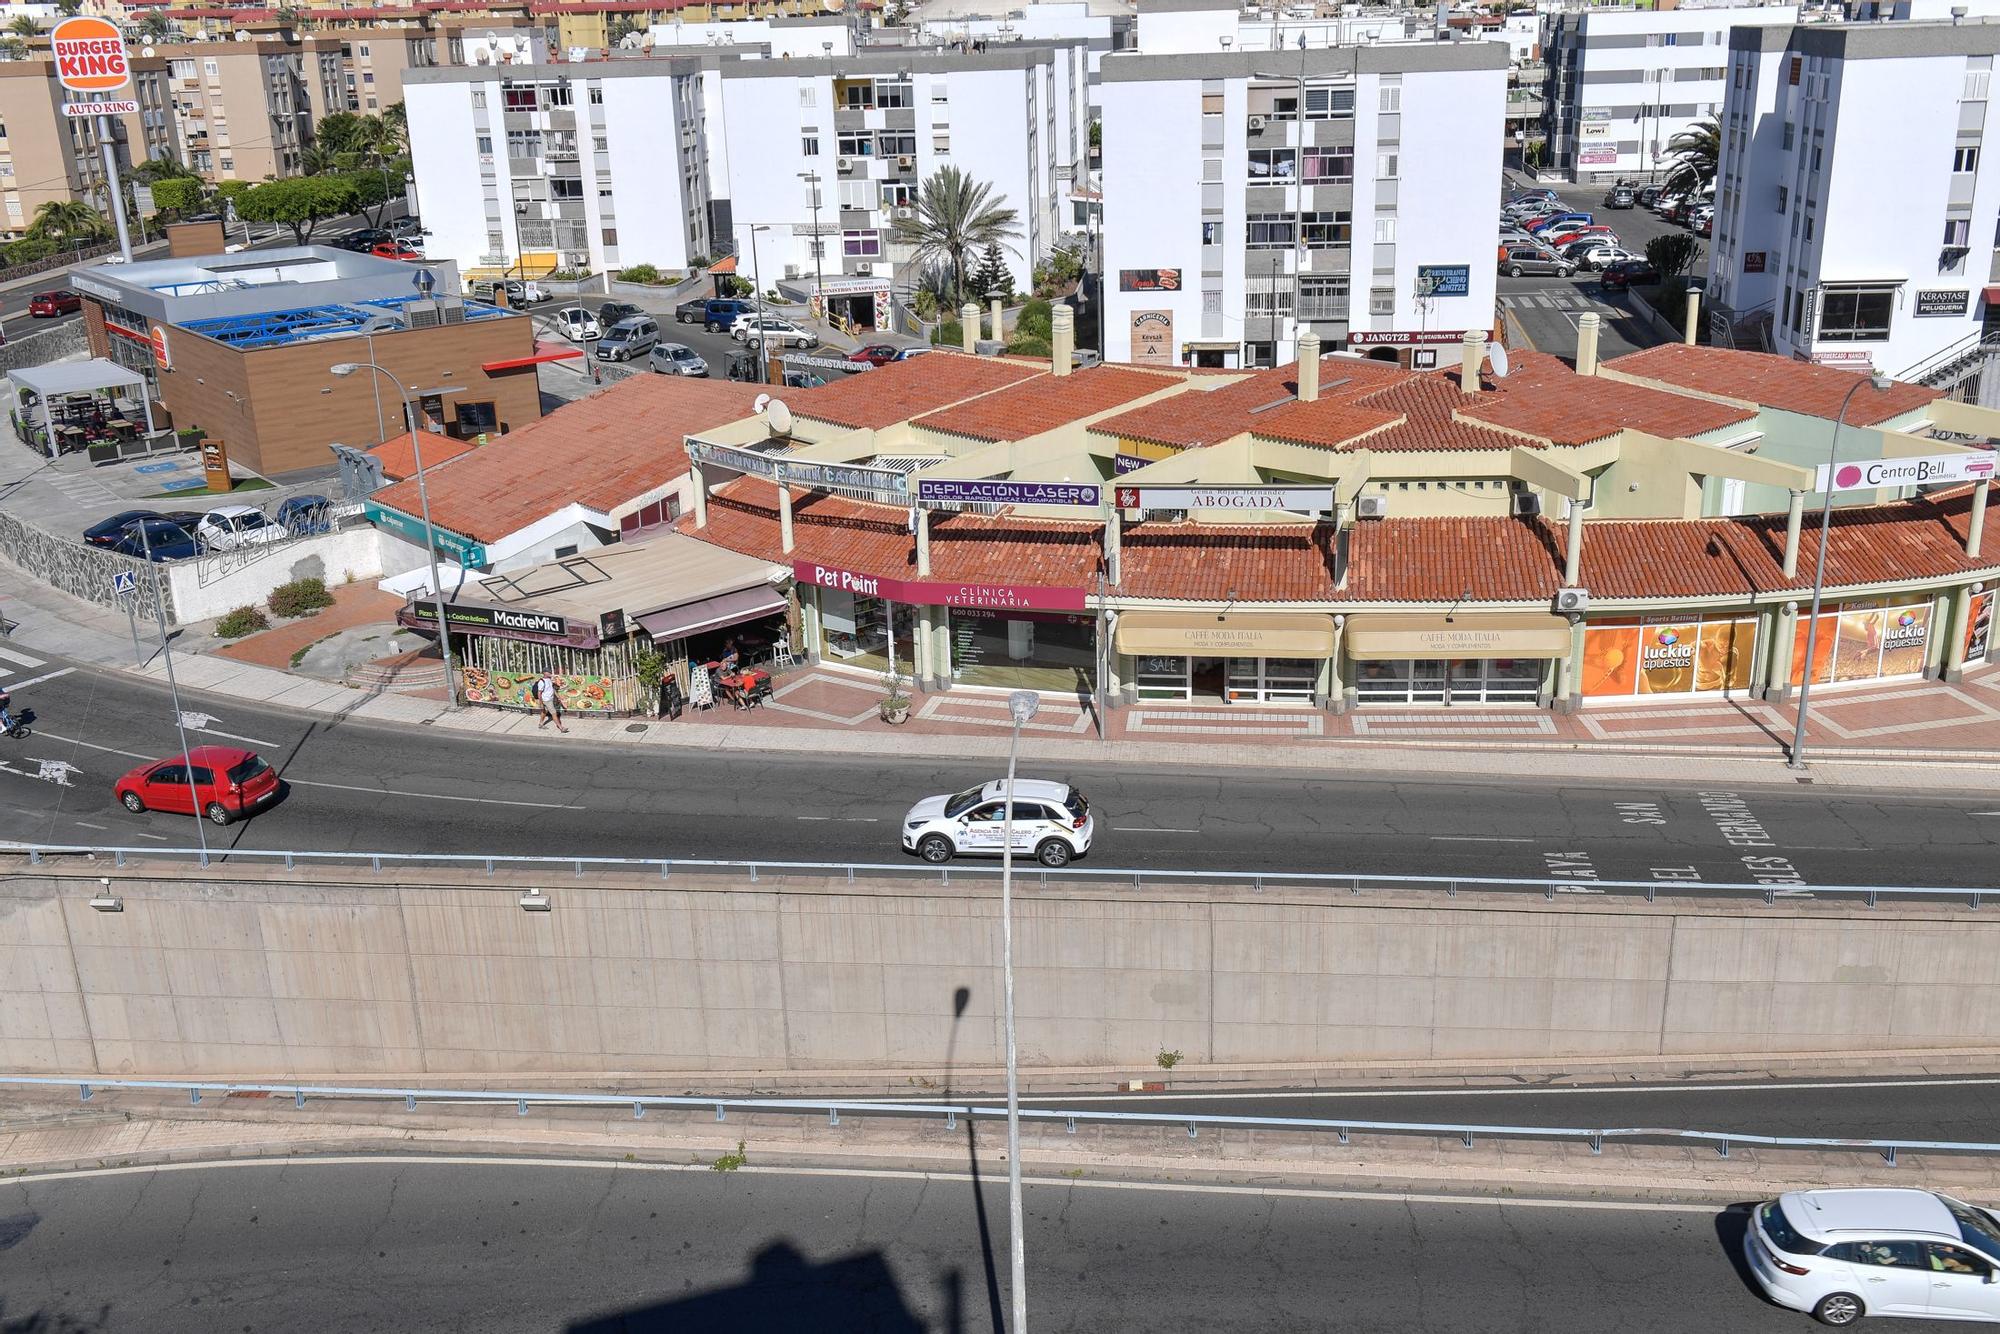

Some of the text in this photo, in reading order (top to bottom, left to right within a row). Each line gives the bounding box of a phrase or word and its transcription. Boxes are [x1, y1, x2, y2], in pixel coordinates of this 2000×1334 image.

[56, 41, 122, 56] BURGER
[60, 54, 125, 76] KING
[68, 101, 135, 115] AUTO KING
[1366, 333, 1410, 342] JANGTZE
[817, 358, 841, 369] HASTA
[841, 360, 873, 371] PRONTO
[1117, 457, 1139, 468] NEW
[922, 482, 1019, 497] DEPILACIÓN
[1024, 485, 1080, 499] LÁSER
[1192, 496, 1285, 508] ABOGADA
[815, 566, 838, 586] Pet
[960, 585, 1014, 598] CLÍNICA
[946, 595, 1030, 607] VETERINARIA
[952, 608, 996, 618] 600 033 294
[1646, 614, 1698, 623] Sports Betting
[494, 610, 559, 632] MadreMia
[1237, 632, 1263, 641] ITALIA
[1447, 632, 1473, 641] MODA
[1475, 632, 1501, 641] ITALIA
[1886, 625, 1925, 640] luckia
[1884, 636, 1924, 651] apuestas
[1644, 645, 1692, 659] luckia
[1150, 658, 1178, 673] SALE
[1643, 657, 1691, 670] apuestas
[1613, 802, 1667, 825] SAN
[1697, 791, 1777, 847] FERNANDO
[1543, 852, 1605, 894] PAYA
